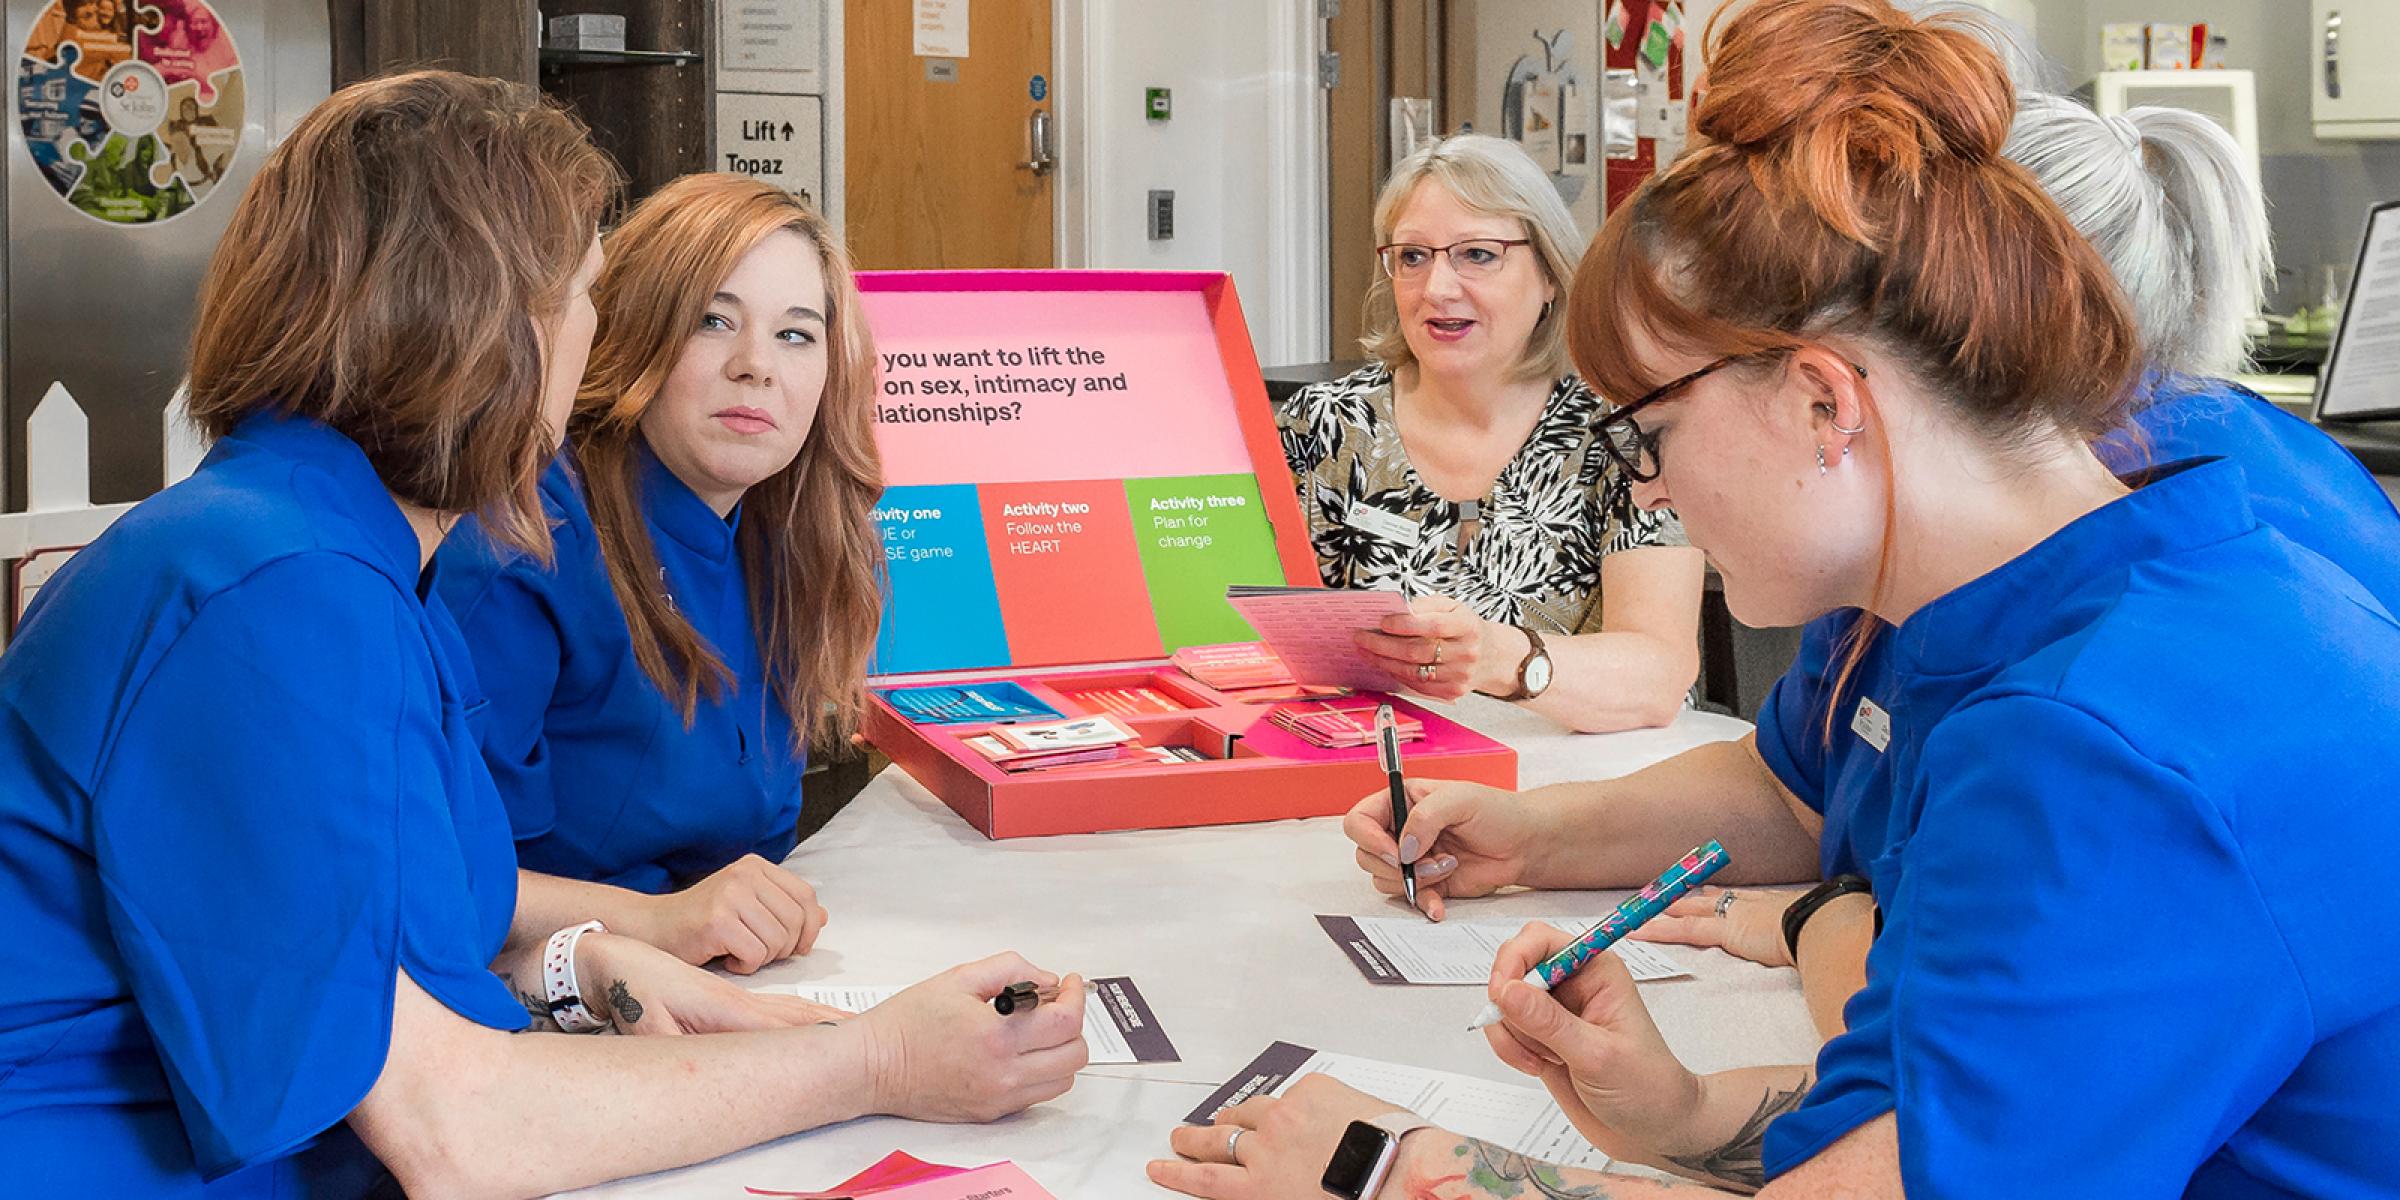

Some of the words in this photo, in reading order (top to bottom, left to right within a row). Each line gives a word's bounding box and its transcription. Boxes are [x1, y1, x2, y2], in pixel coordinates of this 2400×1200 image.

[743, 119, 776, 141] Lift
[725, 152, 783, 178] Topaz
[882, 353, 928, 373] you
[932, 349, 993, 368] want
[996, 348, 1023, 367] to
[1028, 345, 1063, 366] lift
[1065, 346, 1106, 365] the
[884, 380, 915, 396] on
[920, 379, 970, 398] sex,
[974, 374, 1077, 397] intimacy
[1083, 372, 1128, 392] and
[872, 401, 1022, 426] lationships?
[1003, 502, 1059, 518] Activity
[1061, 502, 1090, 514] two
[1150, 496, 1204, 511] Activity
[1206, 495, 1246, 508] three
[913, 509, 942, 520] one
[1153, 515, 1186, 529] Plan
[1188, 514, 1209, 528] for
[901, 529, 917, 540] or
[1006, 521, 1054, 535] Follow
[1057, 520, 1083, 534] the
[1010, 540, 1061, 555] HEART
[1158, 535, 1213, 550] change
[910, 547, 954, 562] game
